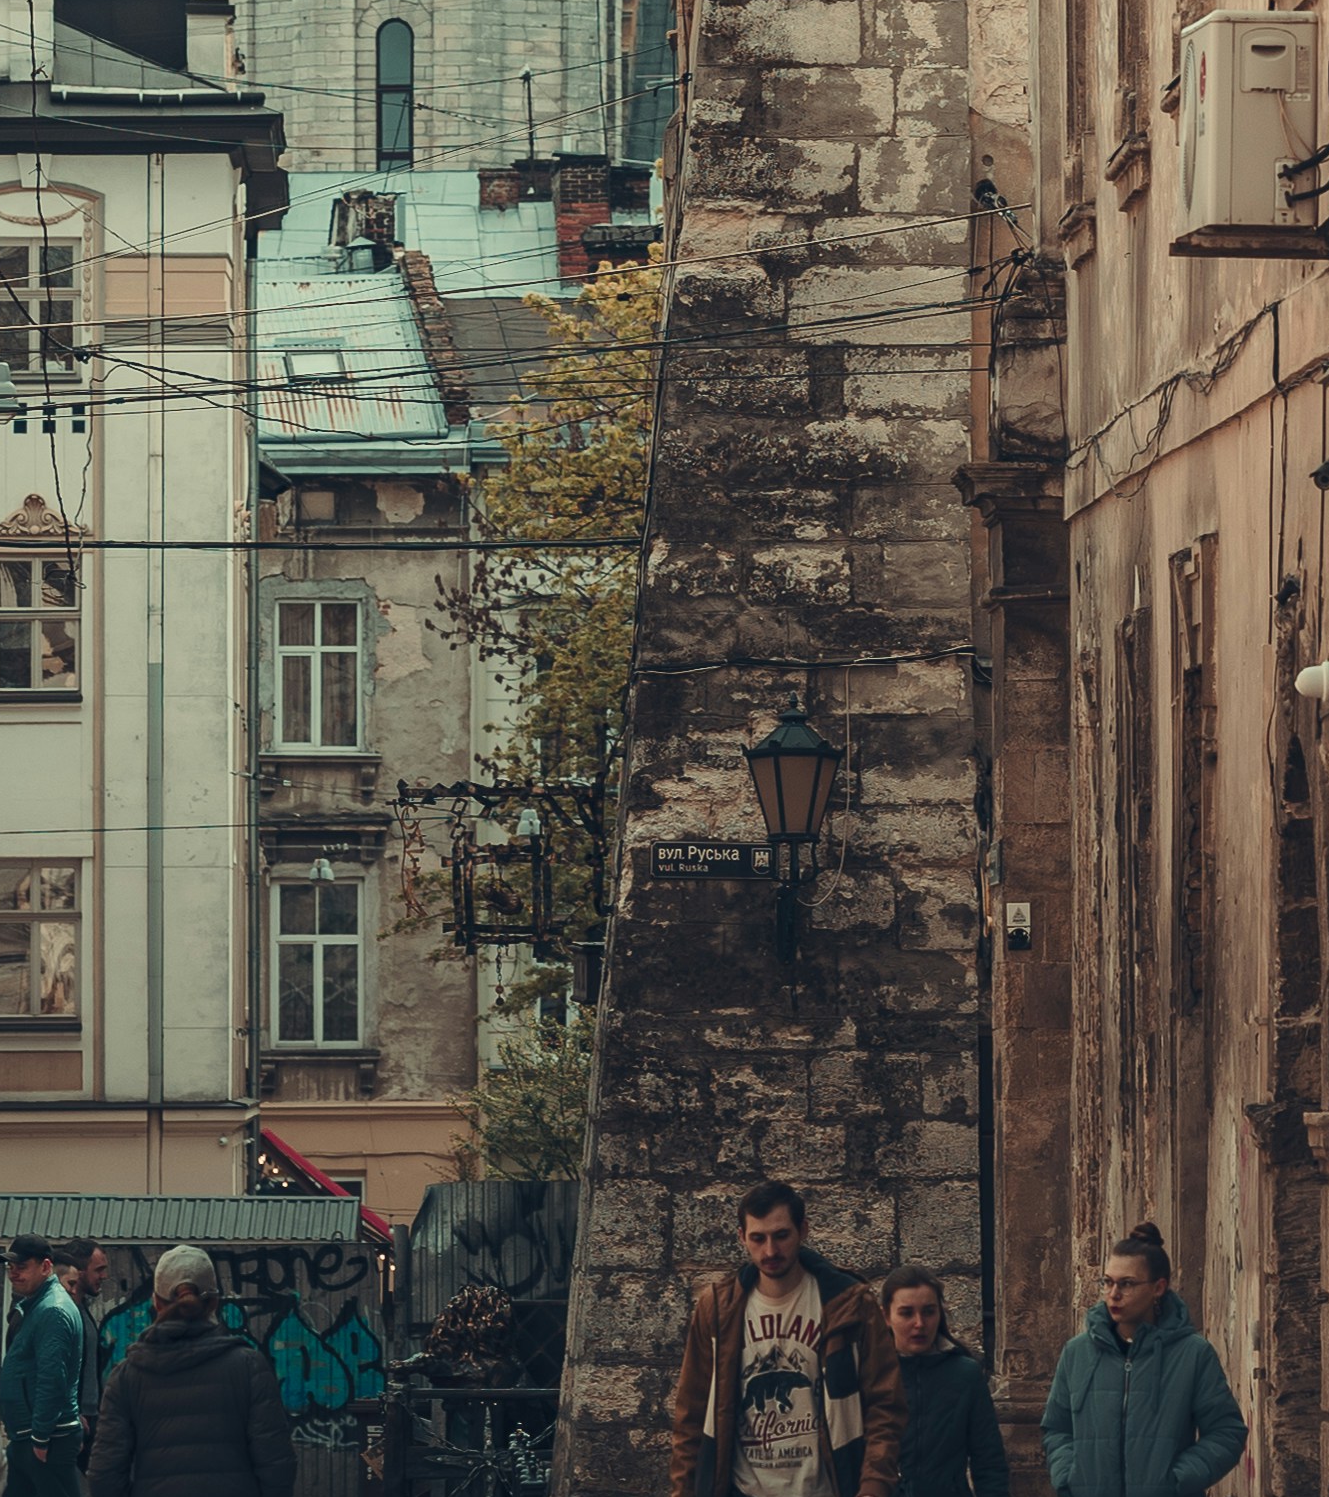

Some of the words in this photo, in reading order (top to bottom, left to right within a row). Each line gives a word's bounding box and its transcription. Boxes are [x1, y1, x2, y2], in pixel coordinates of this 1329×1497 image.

[658, 848, 685, 860] вул.
[688, 846, 740, 862] Руська
[658, 864, 676, 872] vul.
[679, 863, 709, 872] Ruska
[748, 1314, 822, 1352] LDLAN
